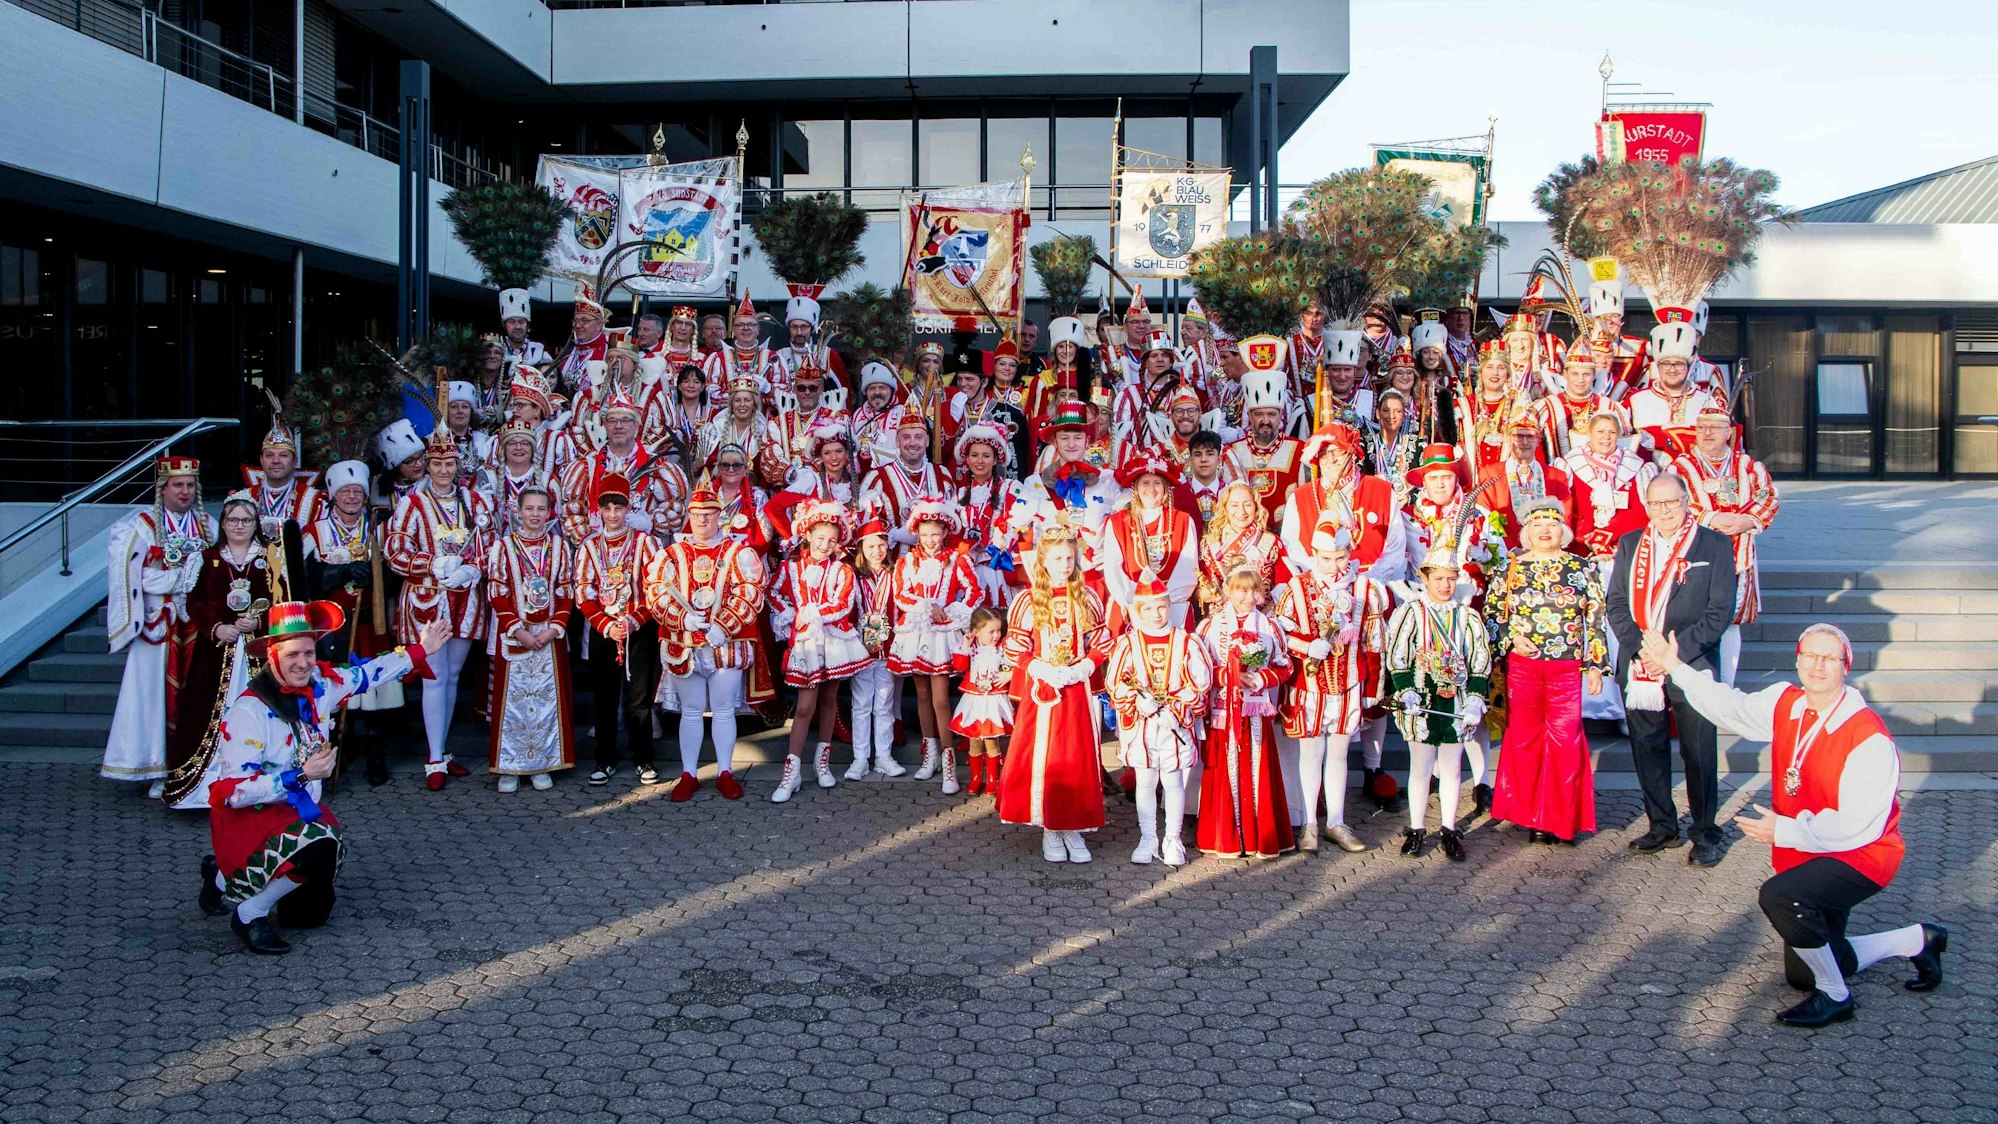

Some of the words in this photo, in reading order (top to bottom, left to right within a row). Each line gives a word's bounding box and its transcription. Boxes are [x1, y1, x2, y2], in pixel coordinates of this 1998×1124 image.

[1625, 124, 1694, 148] URSTADT
[1635, 148, 1669, 162] 1955
[1176, 186, 1204, 195] BLAU
[1175, 195, 1211, 204] WEISS
[1133, 222, 1146, 232] 19
[1199, 224, 1212, 233] 77
[1134, 259, 1188, 270] SCHLEID
[1219, 630, 1229, 667] 2023/2
